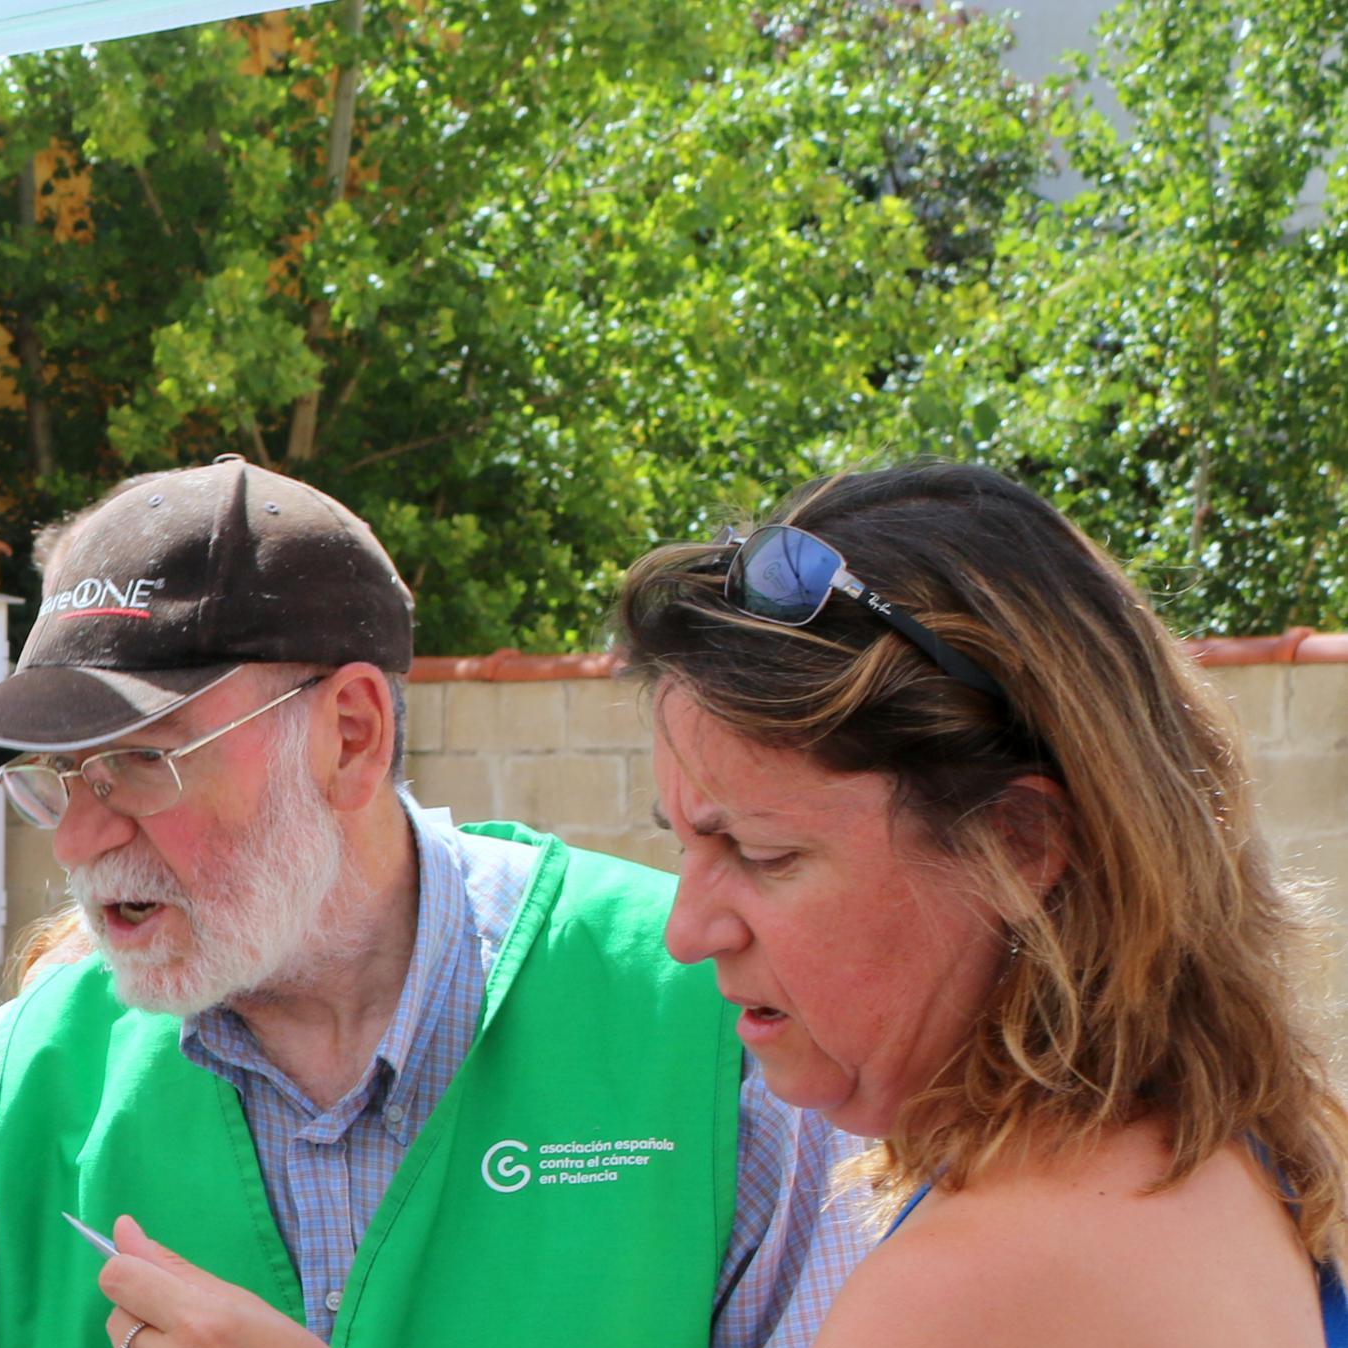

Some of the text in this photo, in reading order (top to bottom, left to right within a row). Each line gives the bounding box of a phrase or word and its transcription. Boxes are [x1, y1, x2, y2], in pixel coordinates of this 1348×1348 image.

[540, 1137, 675, 1154] asociación española
[539, 1153, 650, 1169] contra el cáncer
[539, 1170, 618, 1184] en Palencia
